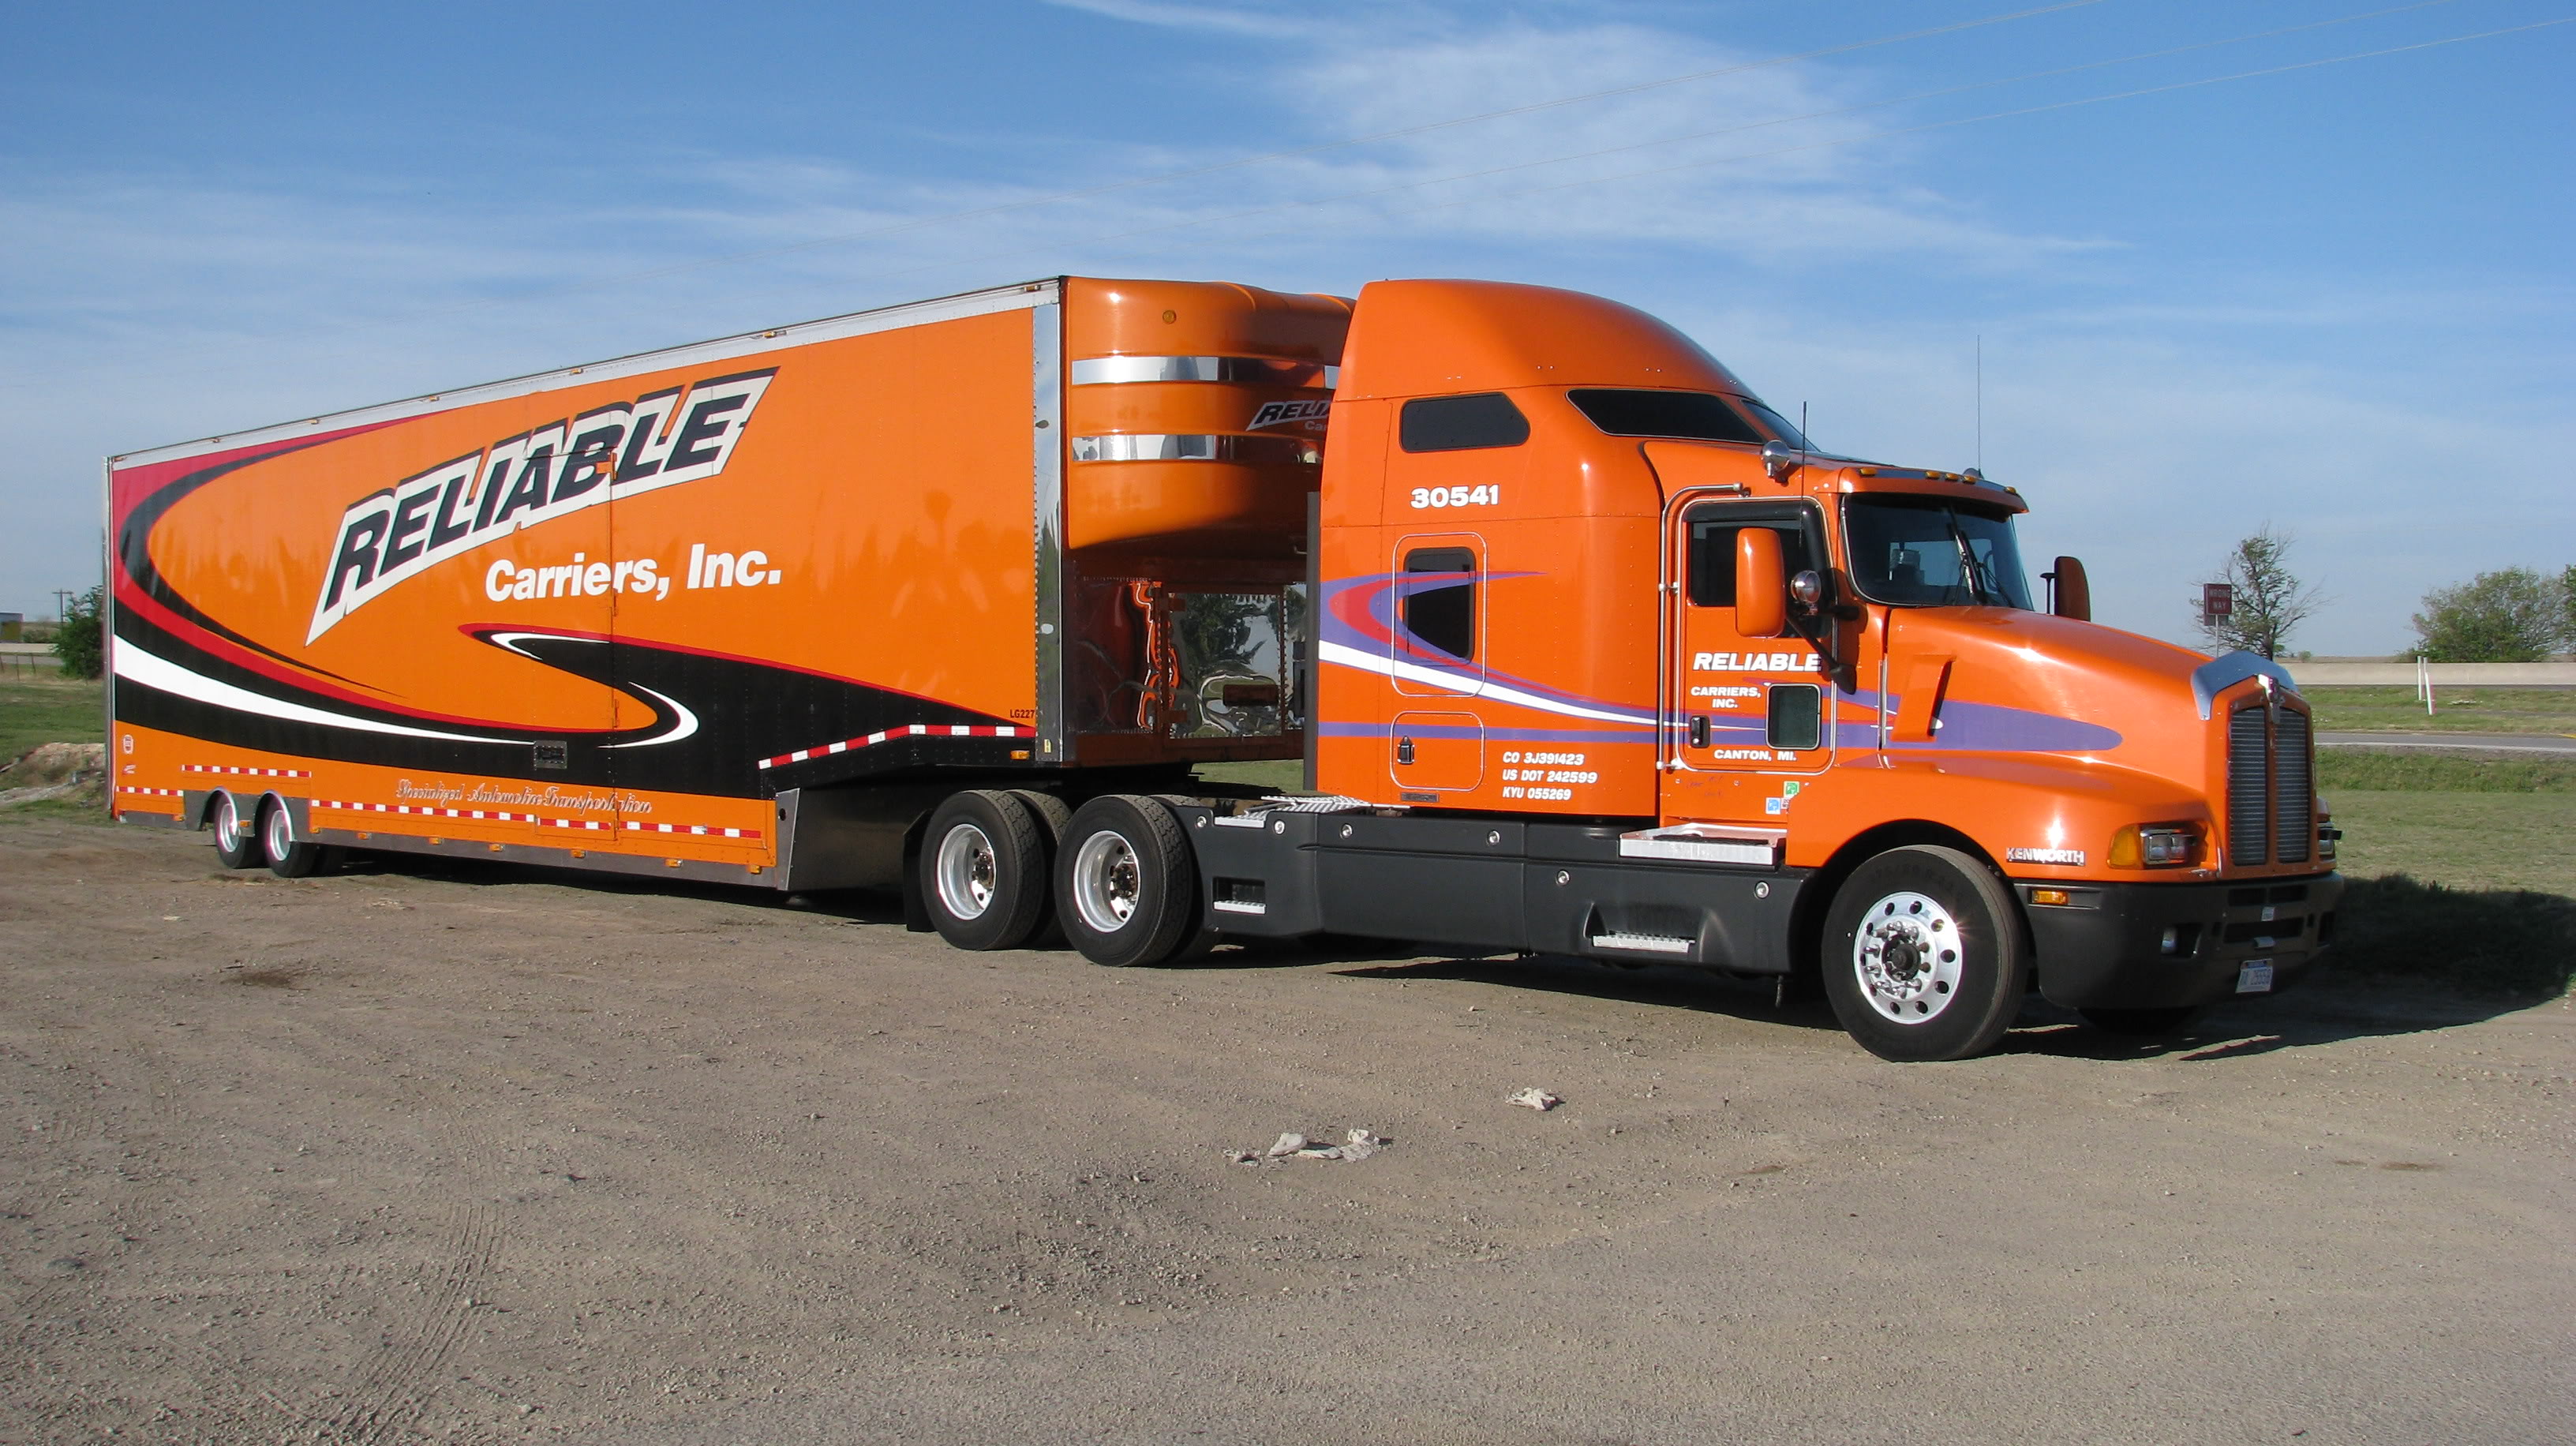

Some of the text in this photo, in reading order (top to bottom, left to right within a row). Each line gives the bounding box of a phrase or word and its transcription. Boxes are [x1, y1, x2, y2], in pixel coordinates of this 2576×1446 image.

[318, 388, 758, 619] RELIABLE
[1410, 484, 1500, 509] 30541
[485, 543, 781, 601] Carriers, Inc.
[2212, 601, 2226, 610] WAY
[1693, 653, 1822, 672] RELIABLE
[1690, 686, 1762, 699] CARRIERS,
[1712, 699, 1739, 709] INC.
[1010, 710, 1035, 719] LG227
[1502, 751, 1521, 764] CO
[1713, 749, 1798, 762] CANTON, MI.
[1502, 769, 1599, 784] US DOT 242599
[1502, 786, 1573, 800] KYU 055269
[2006, 847, 2085, 863] KENWORTH
